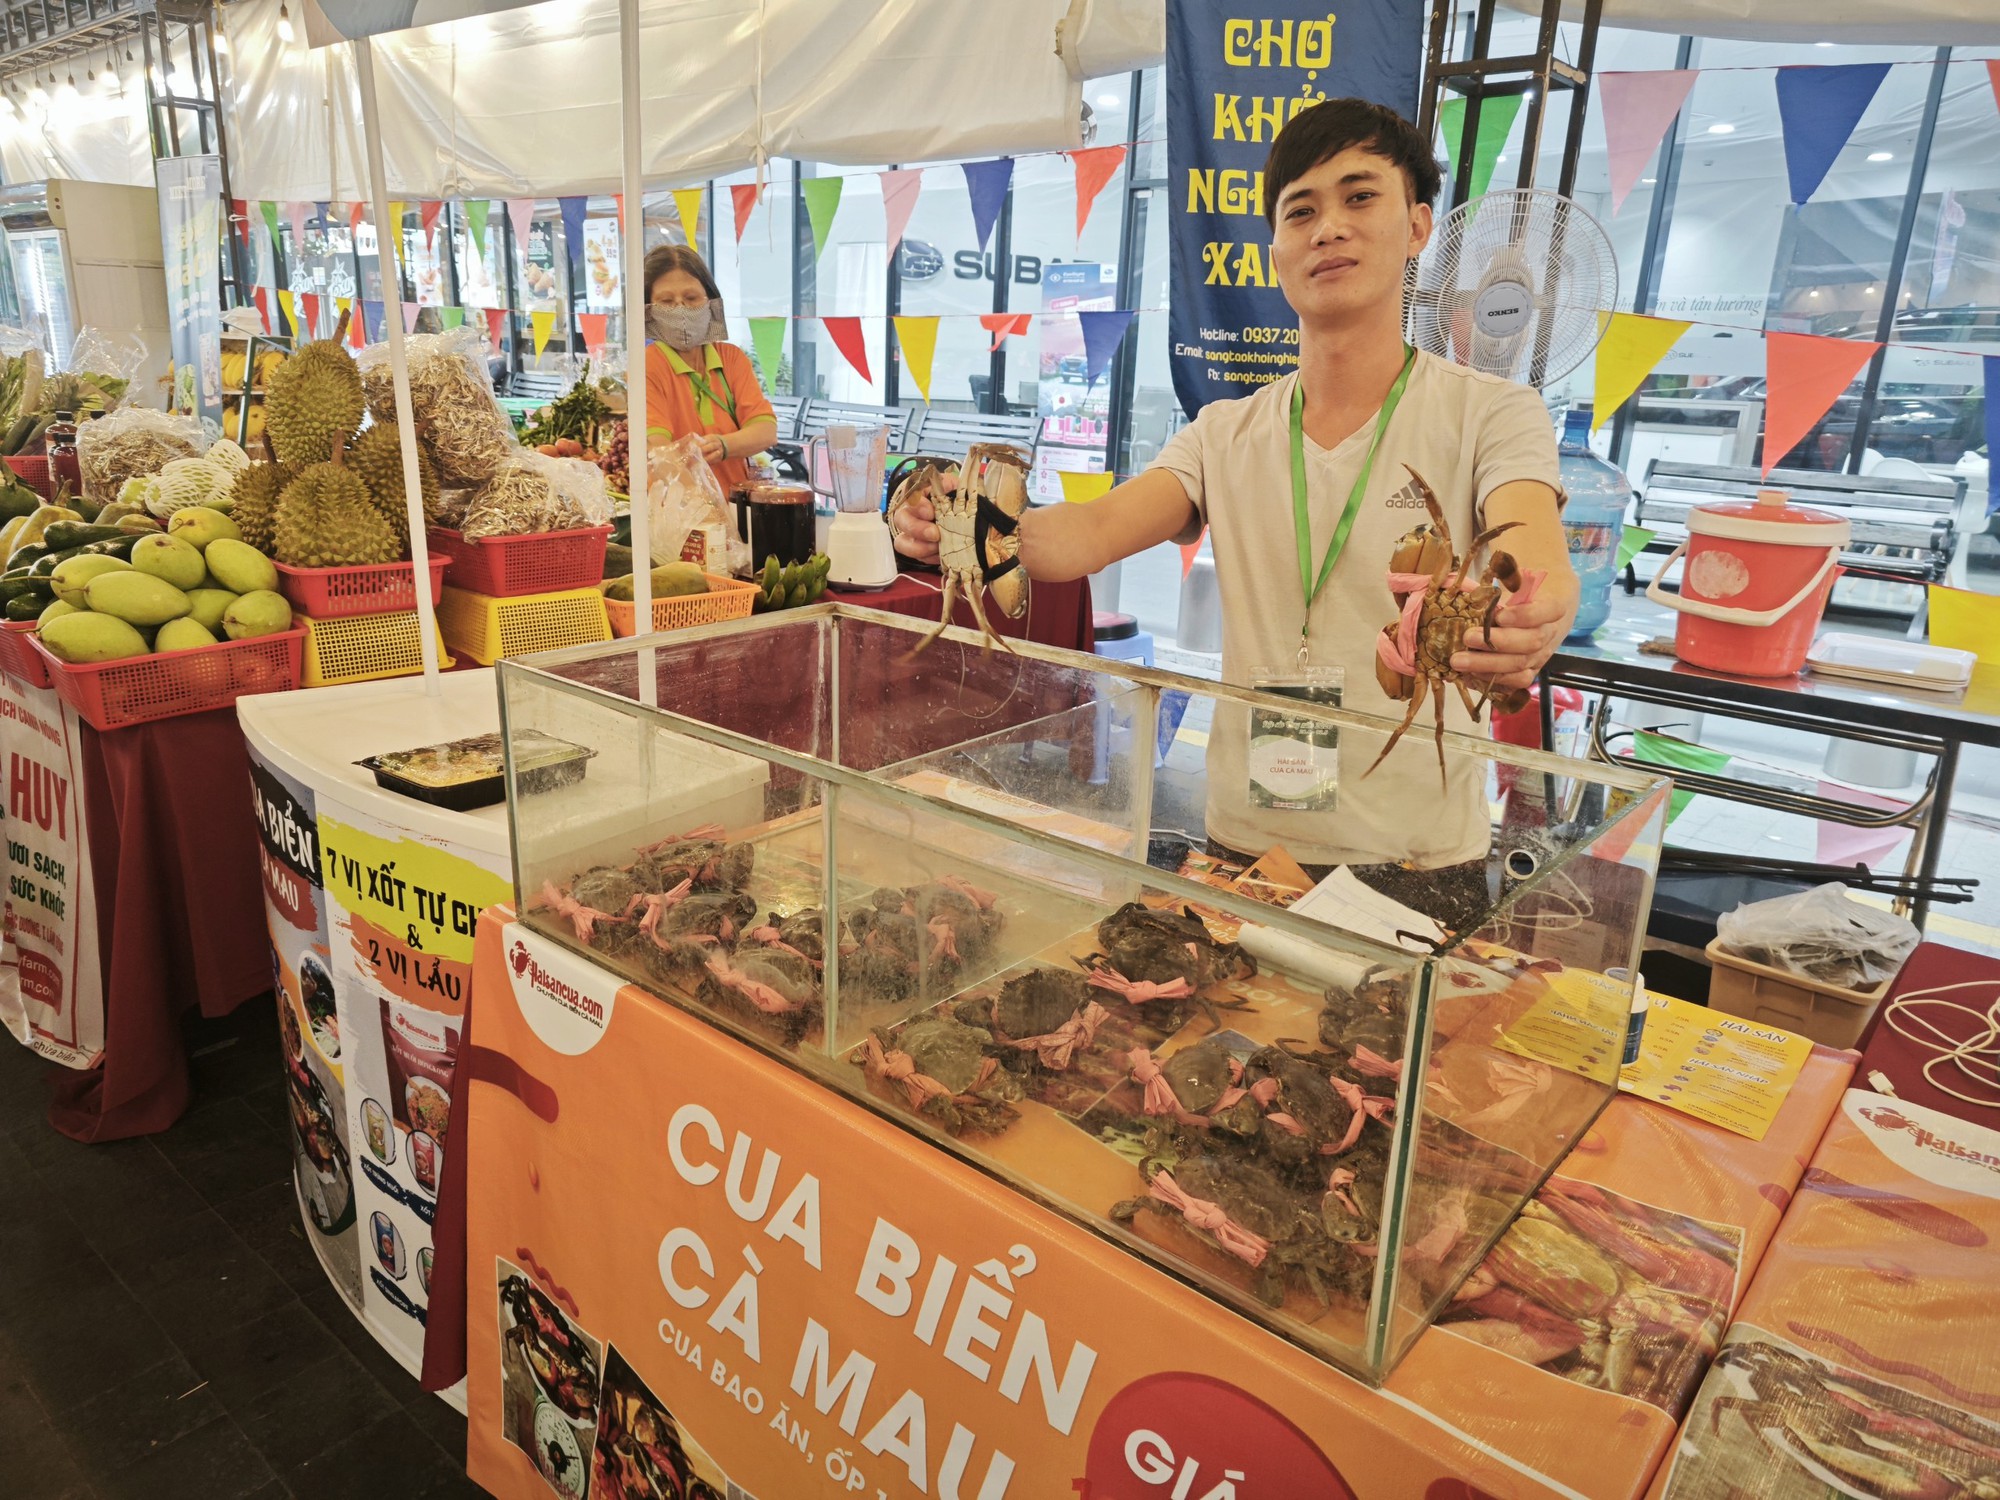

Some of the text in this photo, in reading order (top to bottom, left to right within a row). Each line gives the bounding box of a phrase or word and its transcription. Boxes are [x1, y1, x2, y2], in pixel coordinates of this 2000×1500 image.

[1224, 13, 1336, 80] CHỢ
[1488, 308, 1519, 317] SENKO
[1670, 297, 1687, 312] và
[1200, 327, 1239, 341] Hotline:
[1385, 498, 1428, 509] adida
[10, 751, 67, 842] HUY
[267, 800, 315, 874] BIỂN
[10, 875, 36, 902] SỨC
[40, 887, 65, 922] KHỎE
[34, 852, 66, 889] SẠCH,
[270, 860, 299, 912] MAU
[326, 847, 336, 879] 7
[341, 854, 363, 901] VỊ
[366, 861, 406, 912] XỐT
[413, 886, 446, 935] TỰ
[407, 923, 423, 950] &
[368, 939, 461, 1001] 2 VỊ LẨU
[667, 1103, 1098, 1437] CUA BIỂN
[658, 1226, 1017, 1500] CÀ MAU
[658, 1318, 703, 1372] CUA
[710, 1358, 764, 1415] BAO
[769, 1400, 815, 1464] ĂN,
[824, 1447, 866, 1492] ỐP
